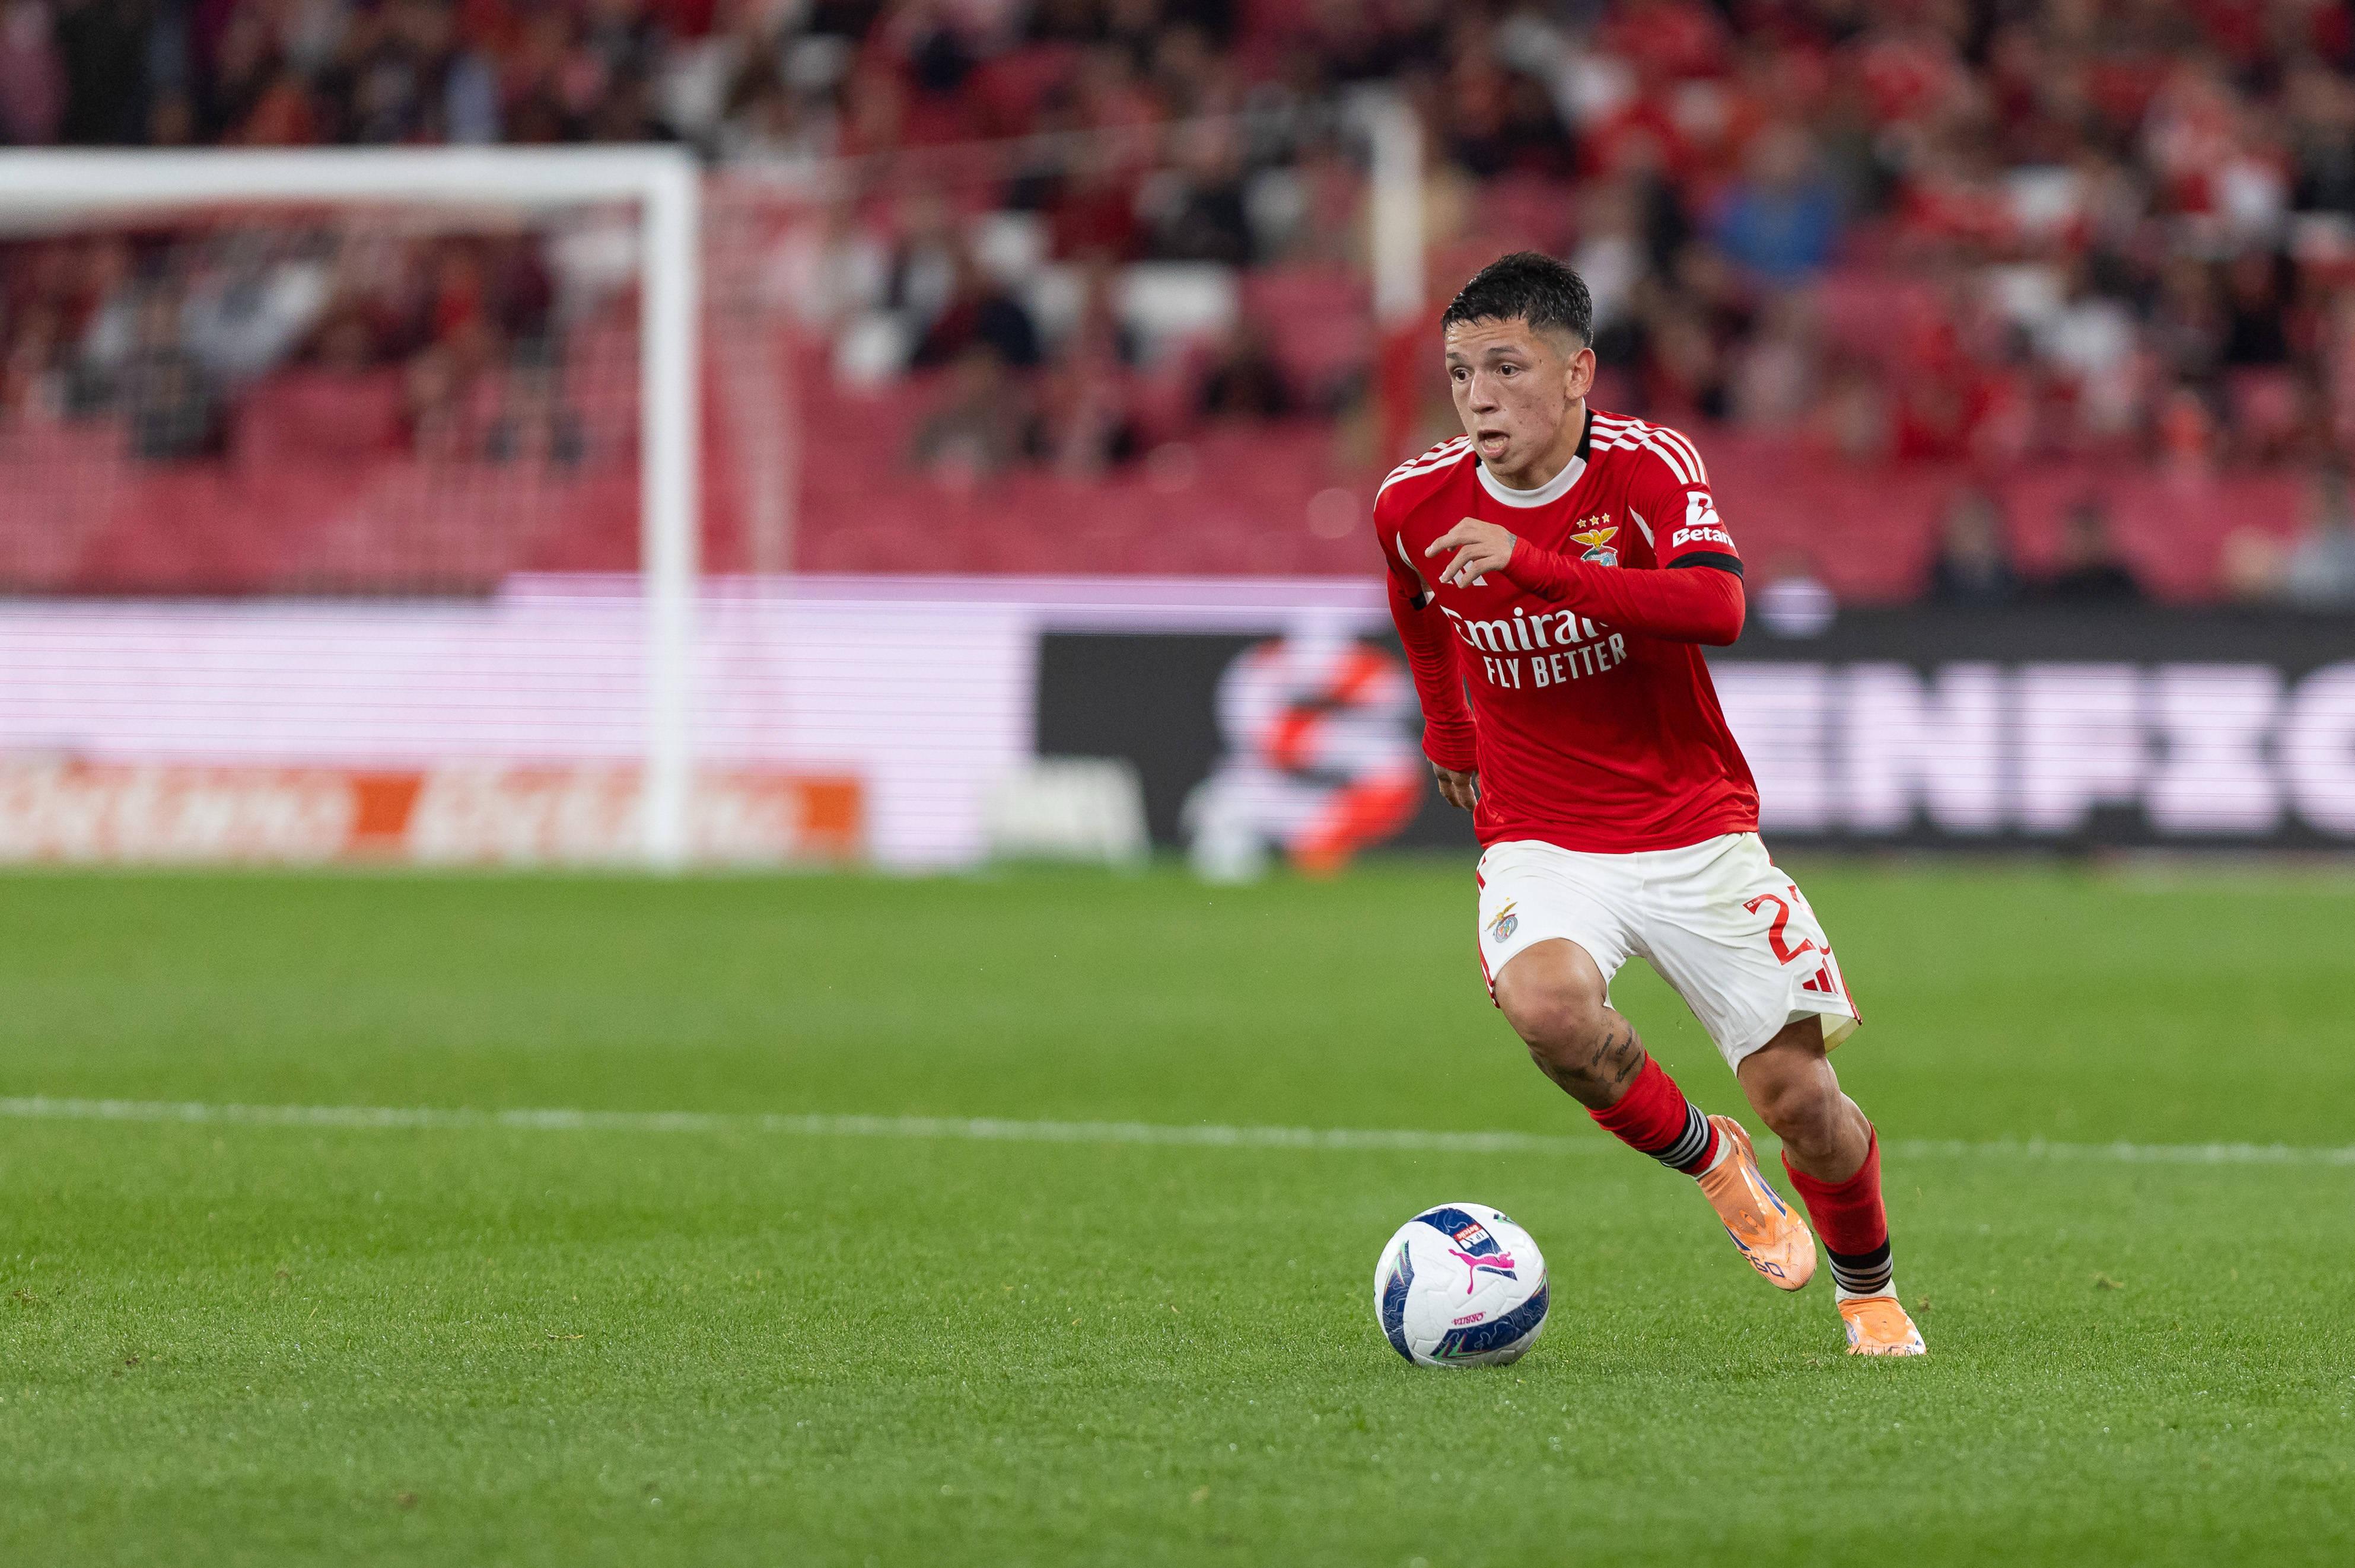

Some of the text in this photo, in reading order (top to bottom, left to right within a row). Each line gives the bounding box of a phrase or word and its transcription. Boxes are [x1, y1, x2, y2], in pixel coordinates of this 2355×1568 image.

[1672, 526, 1736, 548] Betan
[1483, 632, 1627, 689] FLY BETTER
